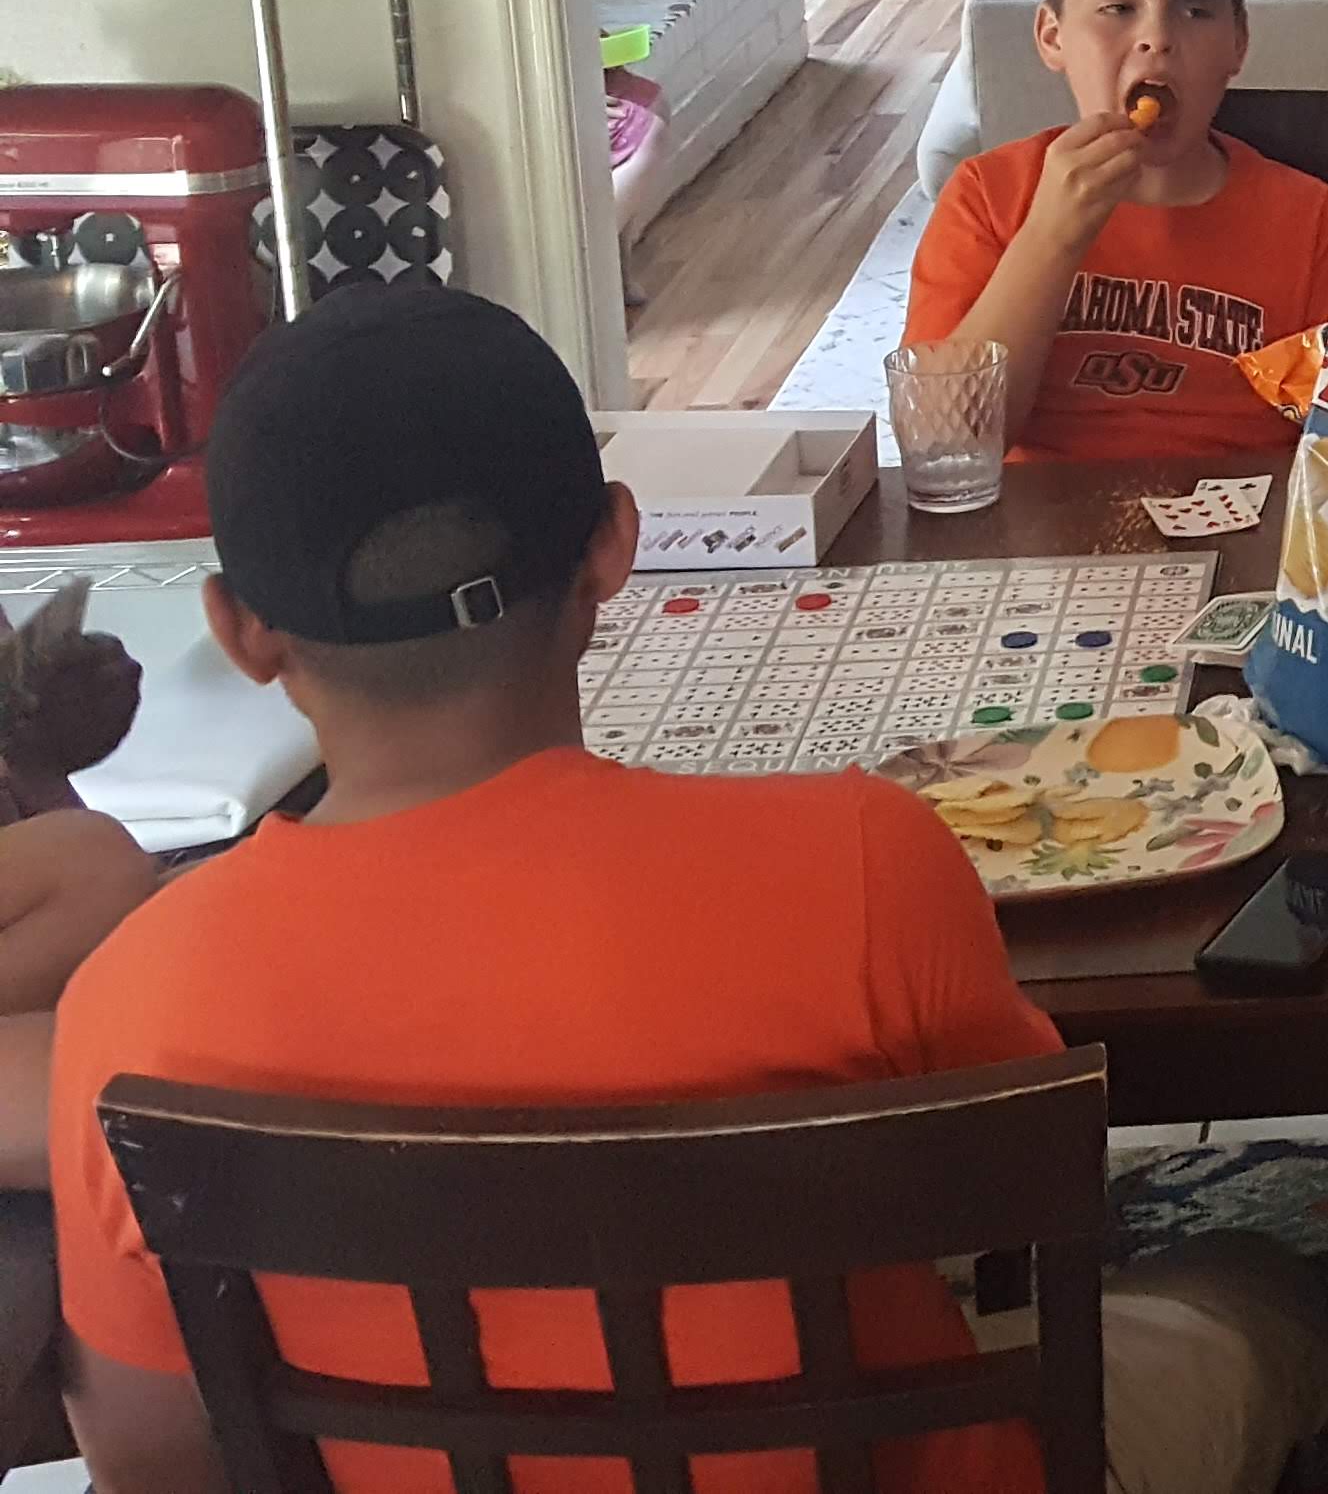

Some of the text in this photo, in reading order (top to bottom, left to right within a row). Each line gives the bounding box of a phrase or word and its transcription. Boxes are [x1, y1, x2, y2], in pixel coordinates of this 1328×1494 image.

[1057, 272, 1172, 343] AHOMA
[1175, 285, 1264, 359] STATE
[1074, 351, 1187, 397] OSU
[1273, 611, 1318, 664] INAL
